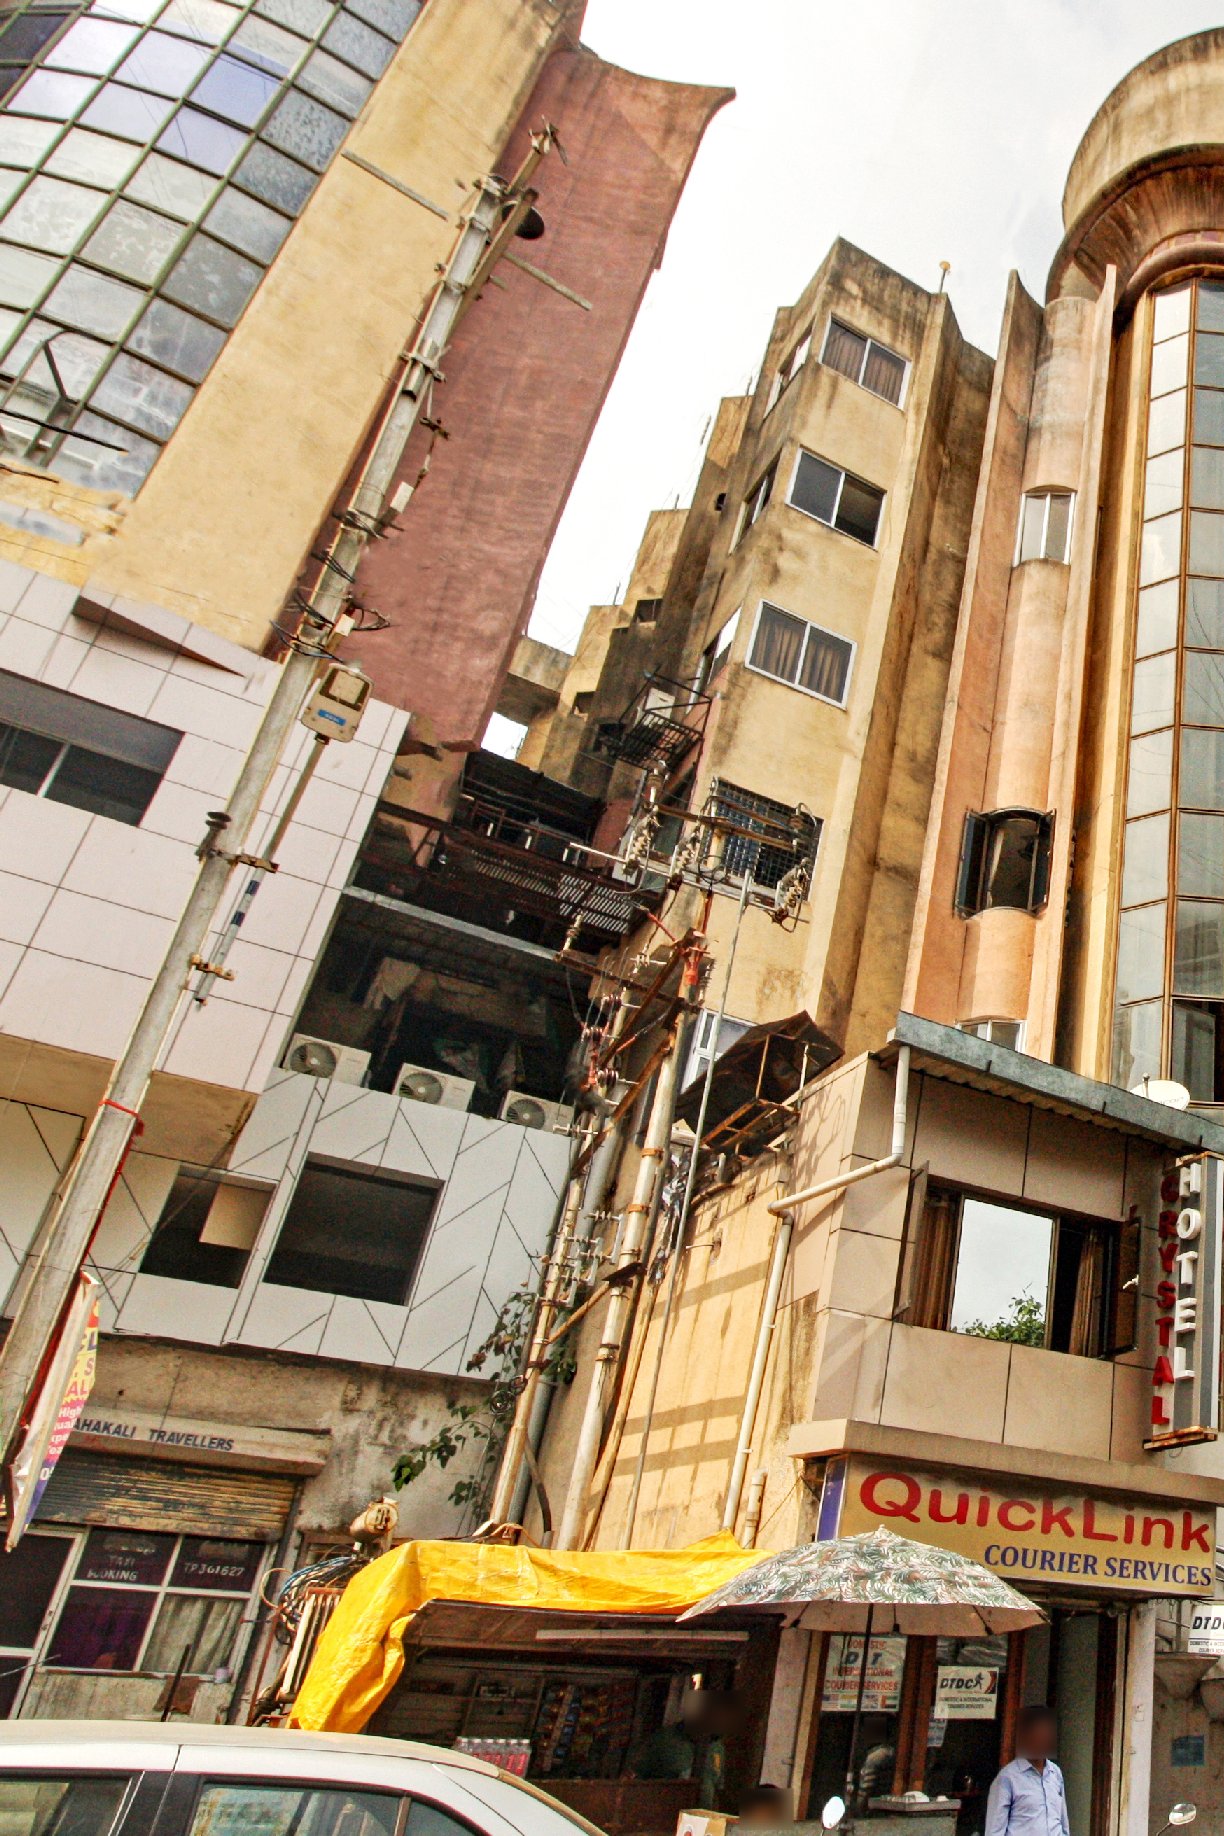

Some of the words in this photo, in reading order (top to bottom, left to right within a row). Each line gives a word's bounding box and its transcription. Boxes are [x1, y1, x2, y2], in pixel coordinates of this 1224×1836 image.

[1151, 1174, 1179, 1425] CRYSTAL
[1174, 1162, 1201, 1380] HOTEL
[74, 1417, 137, 1439] AHAKALI
[149, 1428, 235, 1451] TRAVELLERS
[859, 1471, 1211, 1553] QuickLink
[984, 1544, 1098, 1576] COURIER
[1104, 1556, 1213, 1588] SERVICES
[939, 1676, 974, 1689] DTDC
